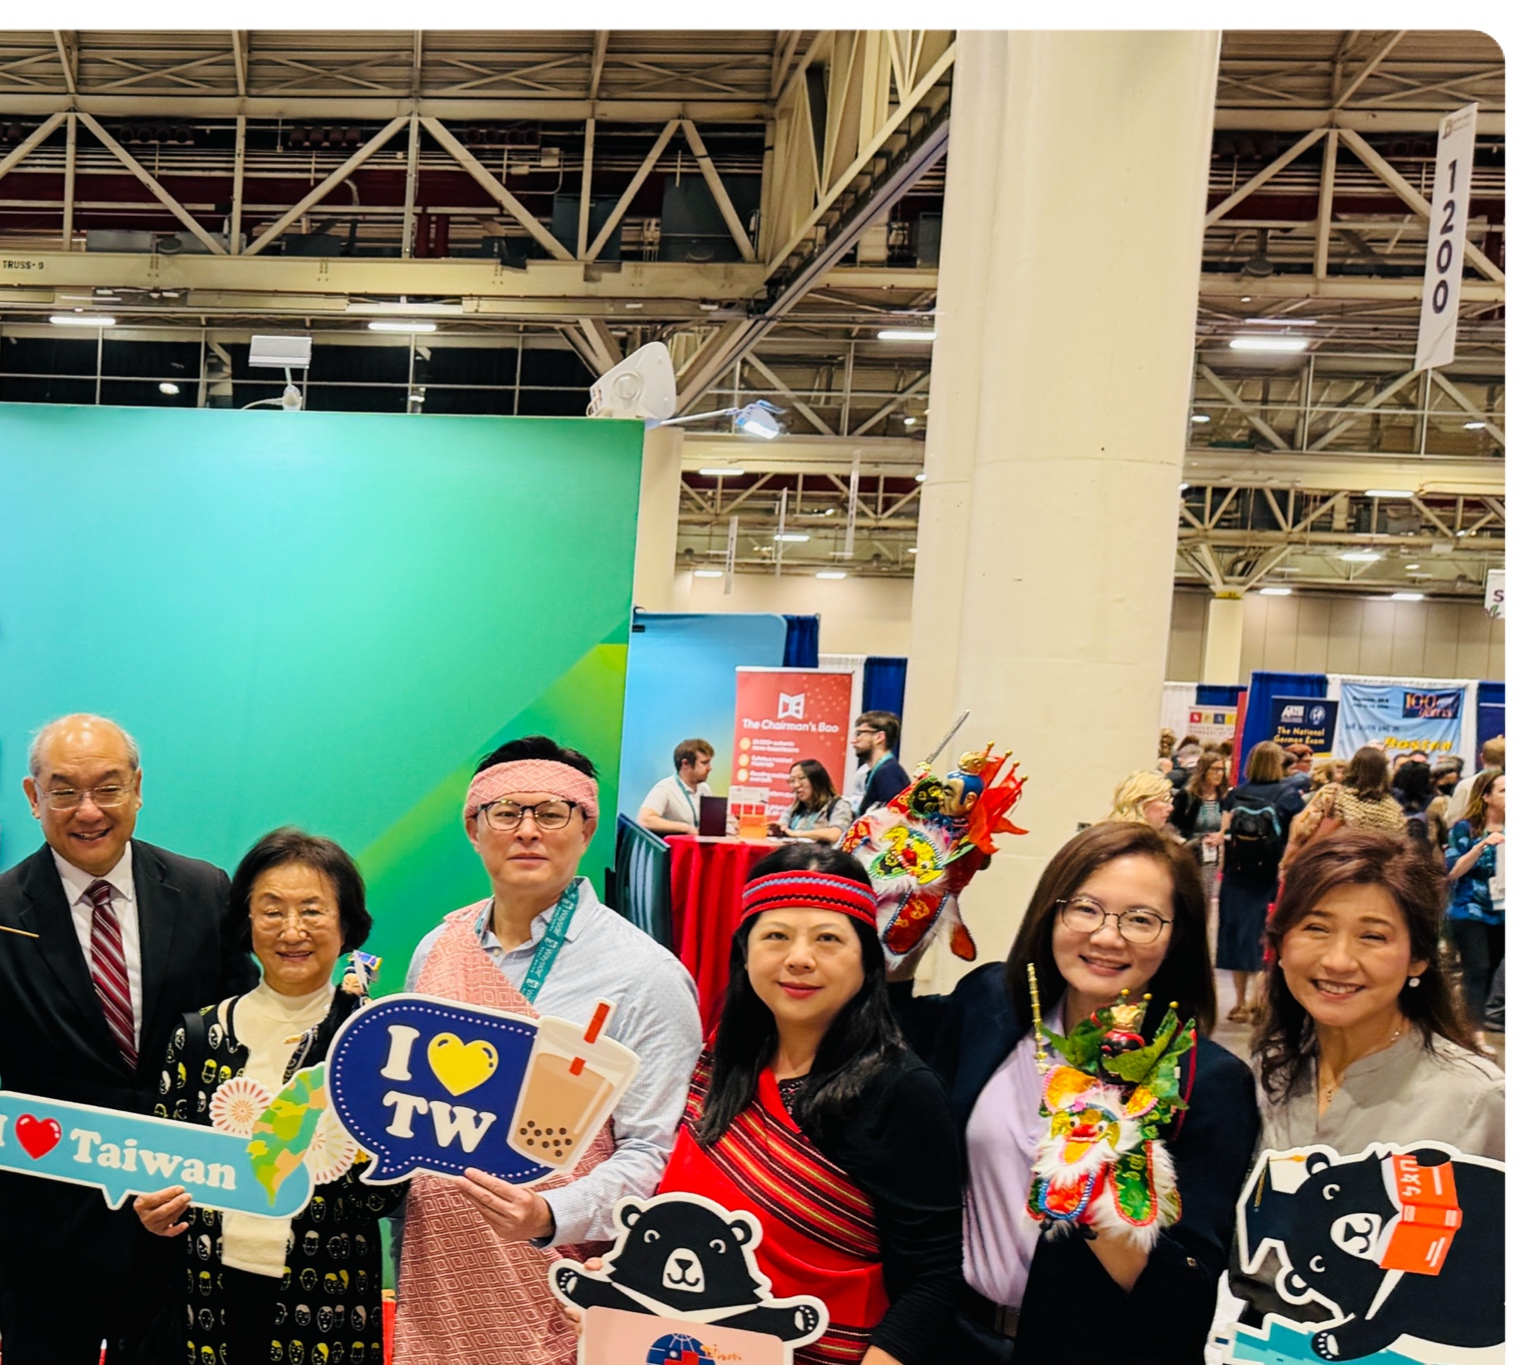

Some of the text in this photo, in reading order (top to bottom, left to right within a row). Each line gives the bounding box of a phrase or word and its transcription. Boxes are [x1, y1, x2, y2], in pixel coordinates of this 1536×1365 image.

[1432, 159, 1457, 314] 1200
[742, 718, 839, 733] The Chairman's Bao
[1273, 735, 1325, 746] German Exam
[1277, 726, 1325, 738] The National
[380, 1024, 420, 1081] I
[382, 1090, 498, 1153] TW
[69, 1128, 237, 1190] Taiwan
